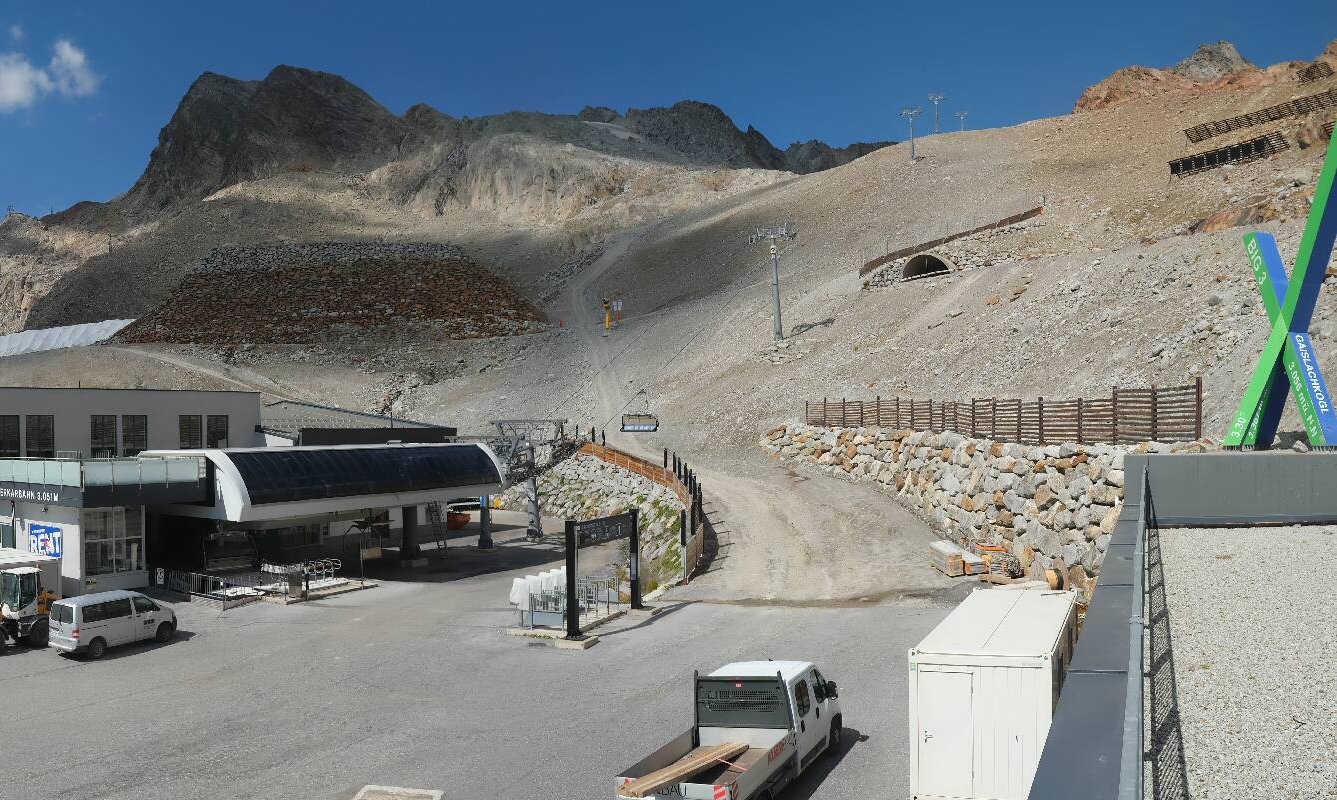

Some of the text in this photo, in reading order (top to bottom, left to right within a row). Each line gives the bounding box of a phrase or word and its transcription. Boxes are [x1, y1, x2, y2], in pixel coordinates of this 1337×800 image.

[1247, 237, 1267, 285] BIG 3
[1295, 334, 1330, 415] GAISLACHKOGL
[30, 531, 61, 556] RENT
